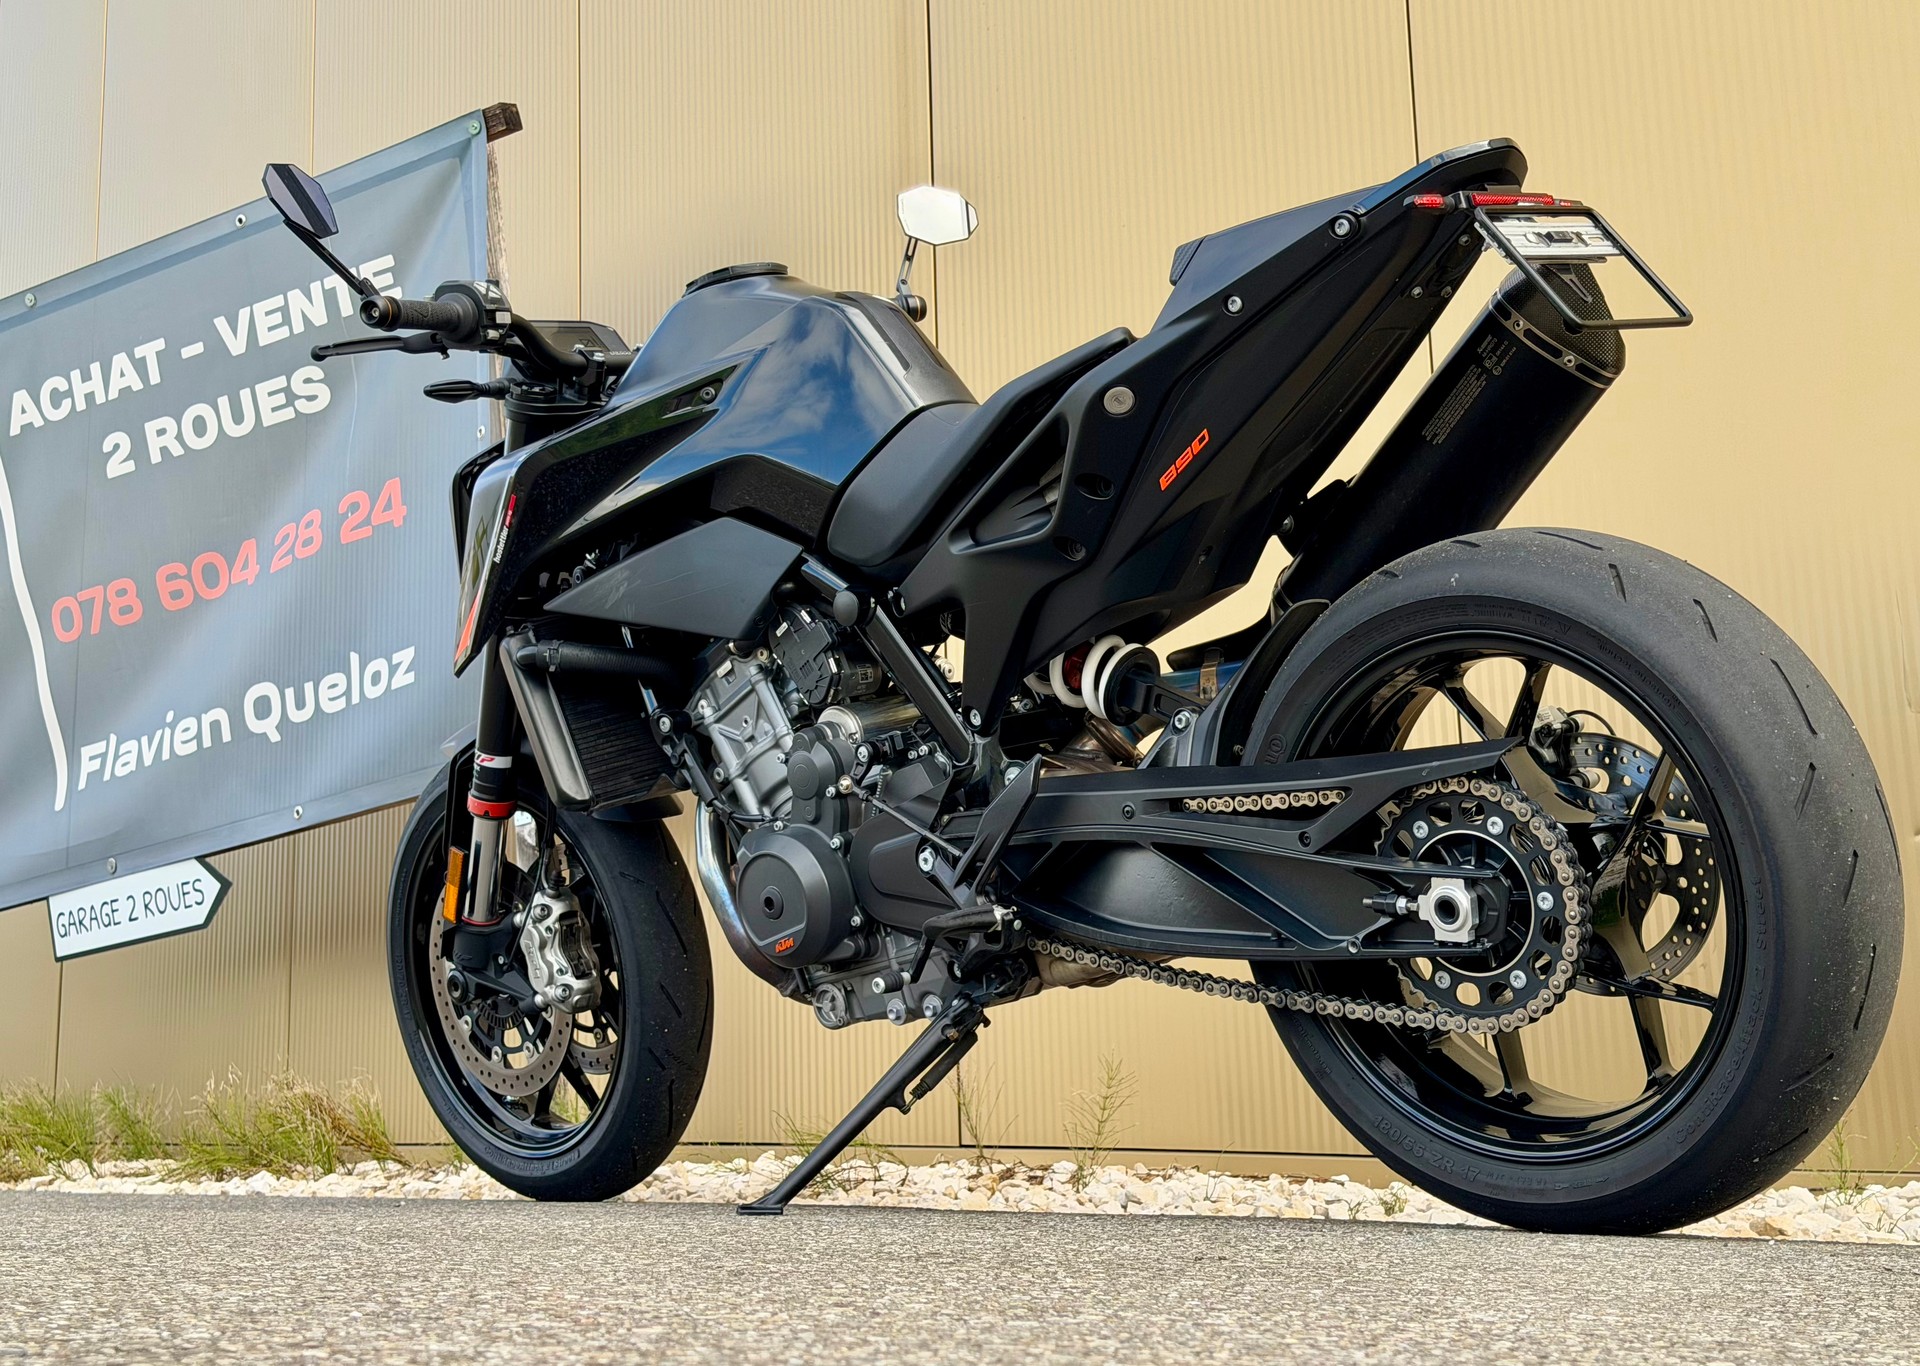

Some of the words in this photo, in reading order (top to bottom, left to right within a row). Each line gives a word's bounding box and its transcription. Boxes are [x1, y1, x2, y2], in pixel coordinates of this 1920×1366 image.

[9, 337, 166, 437] ACHAT
[213, 254, 403, 357] VENTE
[102, 431, 136, 480] 2
[143, 364, 332, 465] ROUES
[1158, 428, 1210, 491] 890
[51, 577, 144, 643] 078
[155, 539, 260, 611] 604
[270, 509, 323, 574] 28
[337, 477, 407, 546] 24
[493, 525, 509, 564] hostettler
[77, 710, 232, 792] Flavien
[243, 646, 416, 744] Queloz
[56, 895, 122, 940] GARAGE
[126, 893, 139, 923] 2
[143, 879, 206, 917] ROUES
[775, 936, 794, 954] KTM
[1372, 1114, 1426, 1159] 180/55
[1428, 1150, 1456, 1176] ZR
[1460, 1166, 1482, 1182] 17
